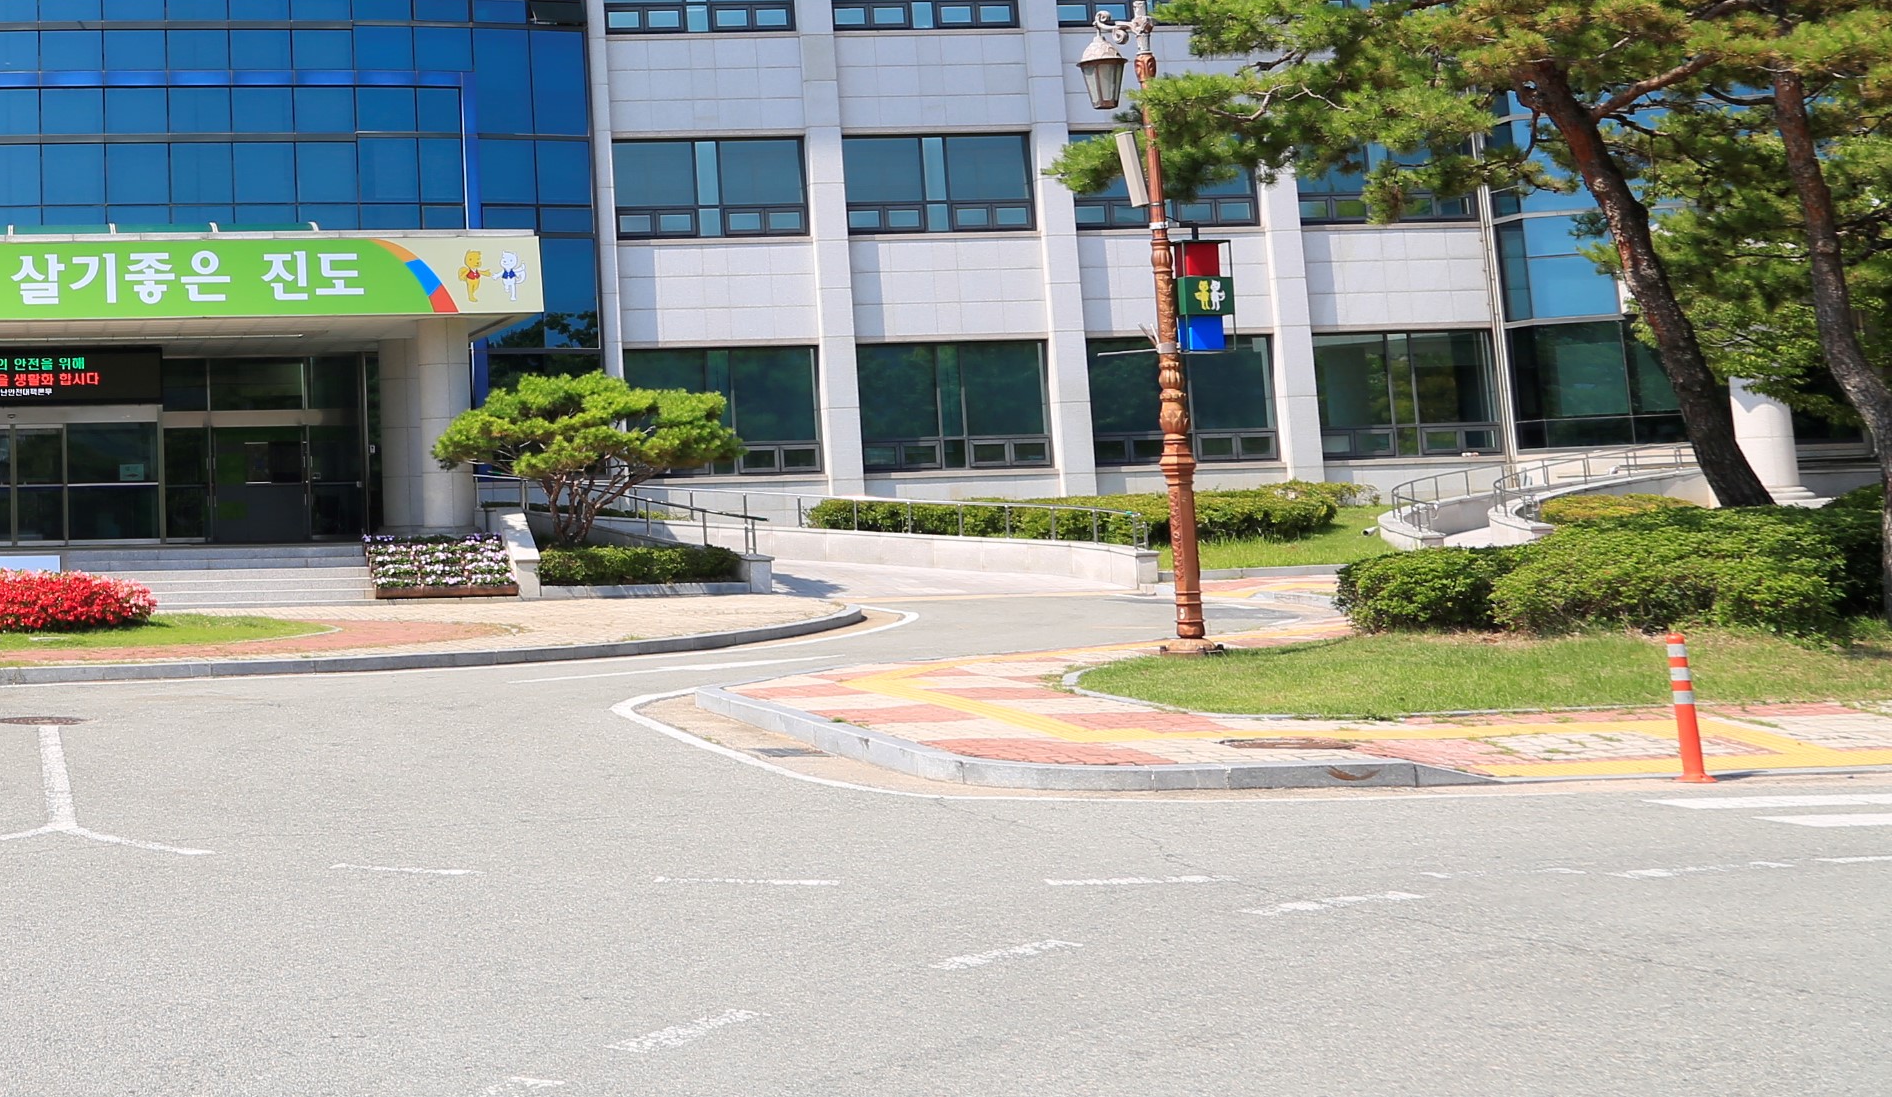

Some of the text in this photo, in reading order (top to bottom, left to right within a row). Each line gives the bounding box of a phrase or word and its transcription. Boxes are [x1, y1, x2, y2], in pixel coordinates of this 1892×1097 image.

[10, 249, 232, 305] 살기좋은
[260, 250, 365, 301] 진도
[13, 357, 54, 371] 안전을
[58, 356, 85, 370] 위해
[13, 373, 55, 387] 생활화
[58, 372, 100, 386] 합시다
